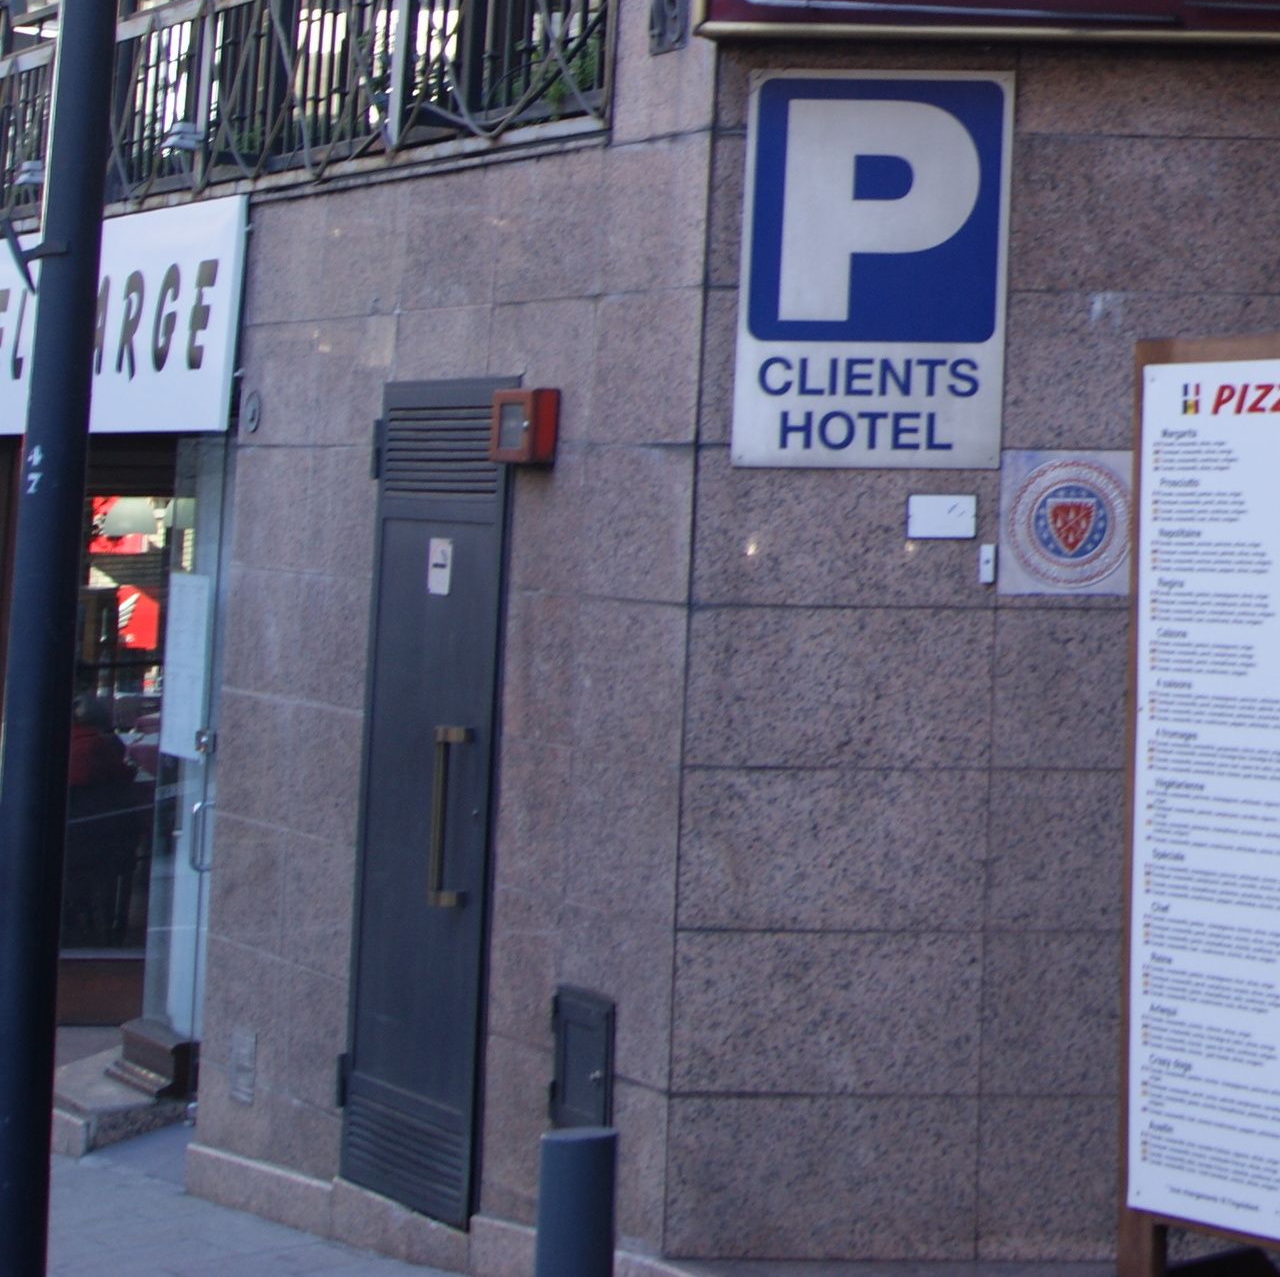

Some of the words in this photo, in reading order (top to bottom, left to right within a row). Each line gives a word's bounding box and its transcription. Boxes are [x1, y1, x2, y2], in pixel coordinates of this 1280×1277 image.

[776, 98, 982, 322] P
[756, 355, 980, 399] CLIENTS
[777, 410, 954, 453] HOTEL
